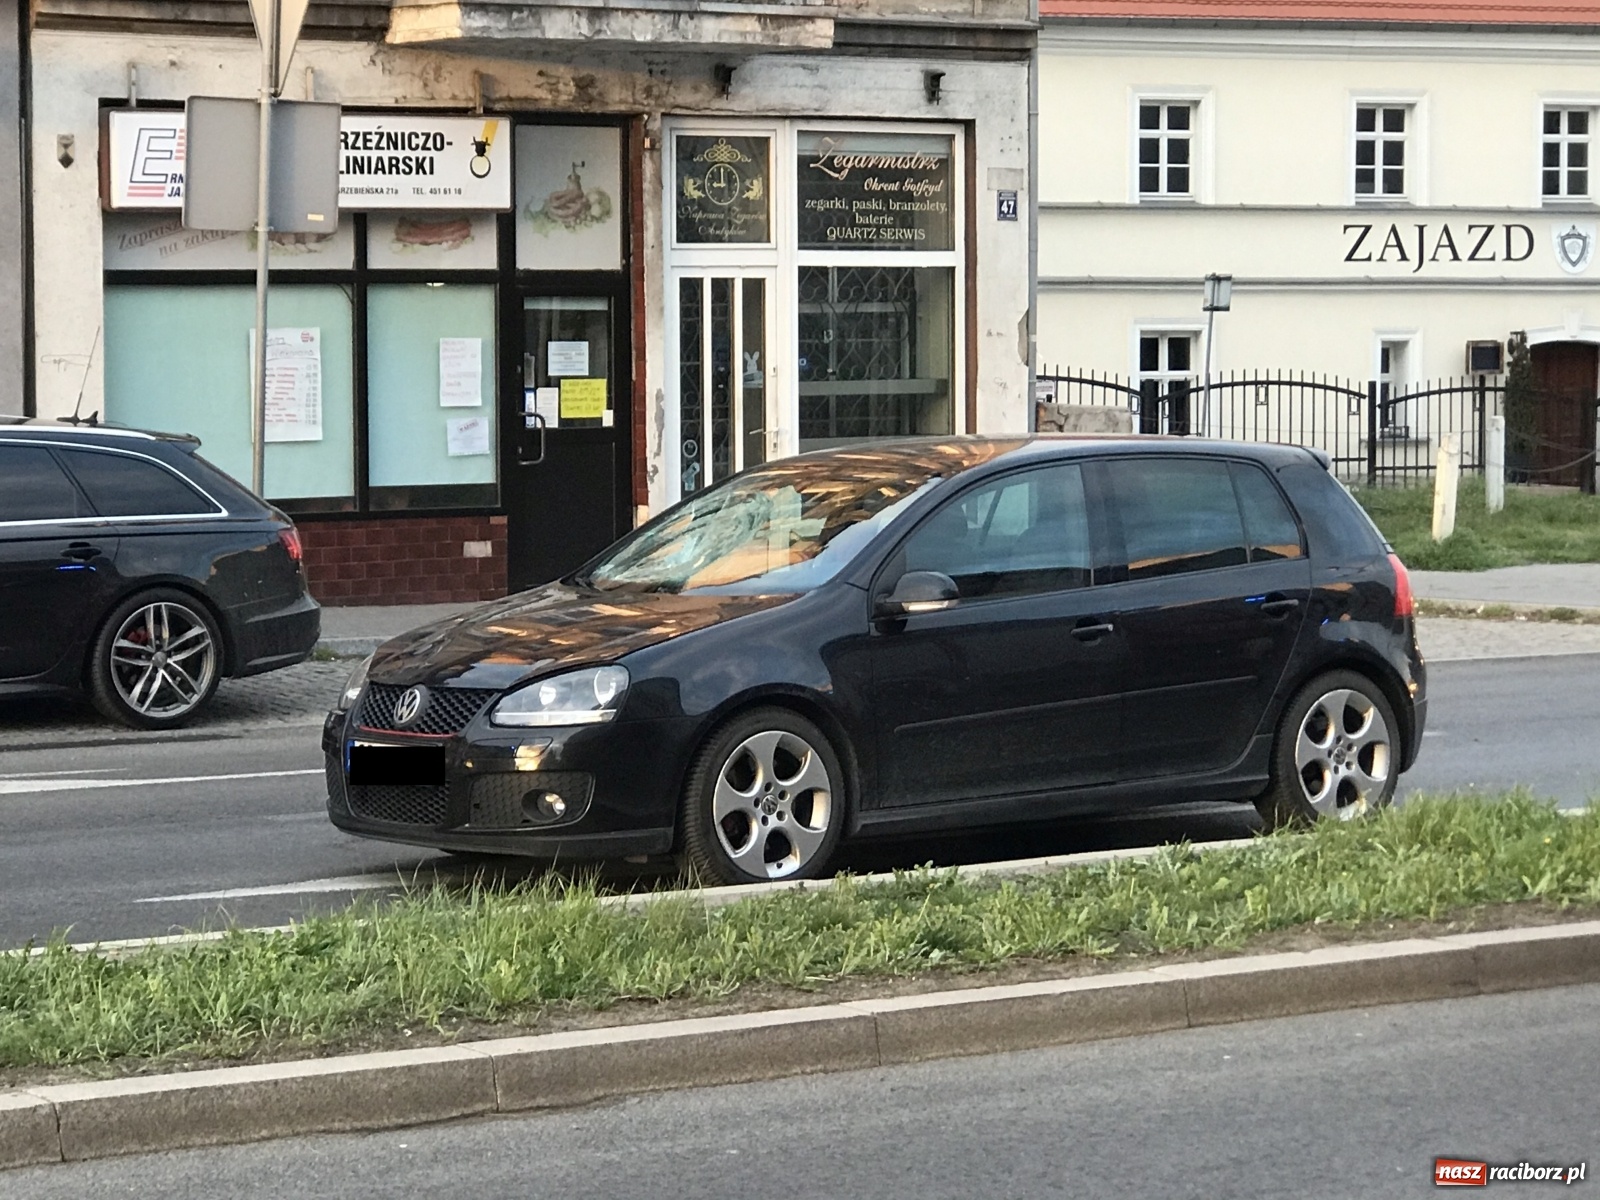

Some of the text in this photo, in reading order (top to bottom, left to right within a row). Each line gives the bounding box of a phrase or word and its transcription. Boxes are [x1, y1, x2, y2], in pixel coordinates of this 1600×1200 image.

[809, 137, 940, 180] Zegarmistrz
[338, 185, 384, 195] RZEBIEŃSKA
[412, 187, 427, 195] TEL.
[902, 177, 944, 197] Gotfryd
[805, 198, 849, 212] zegarki,
[852, 199, 886, 213] paski,
[1001, 200, 1015, 214] 47
[855, 212, 894, 225] baterie
[117, 220, 184, 250] Zaprasz
[826, 227, 926, 241] QUARTZ SERWIS
[158, 243, 178, 257] na
[1343, 223, 1535, 273] ZAJAZD
